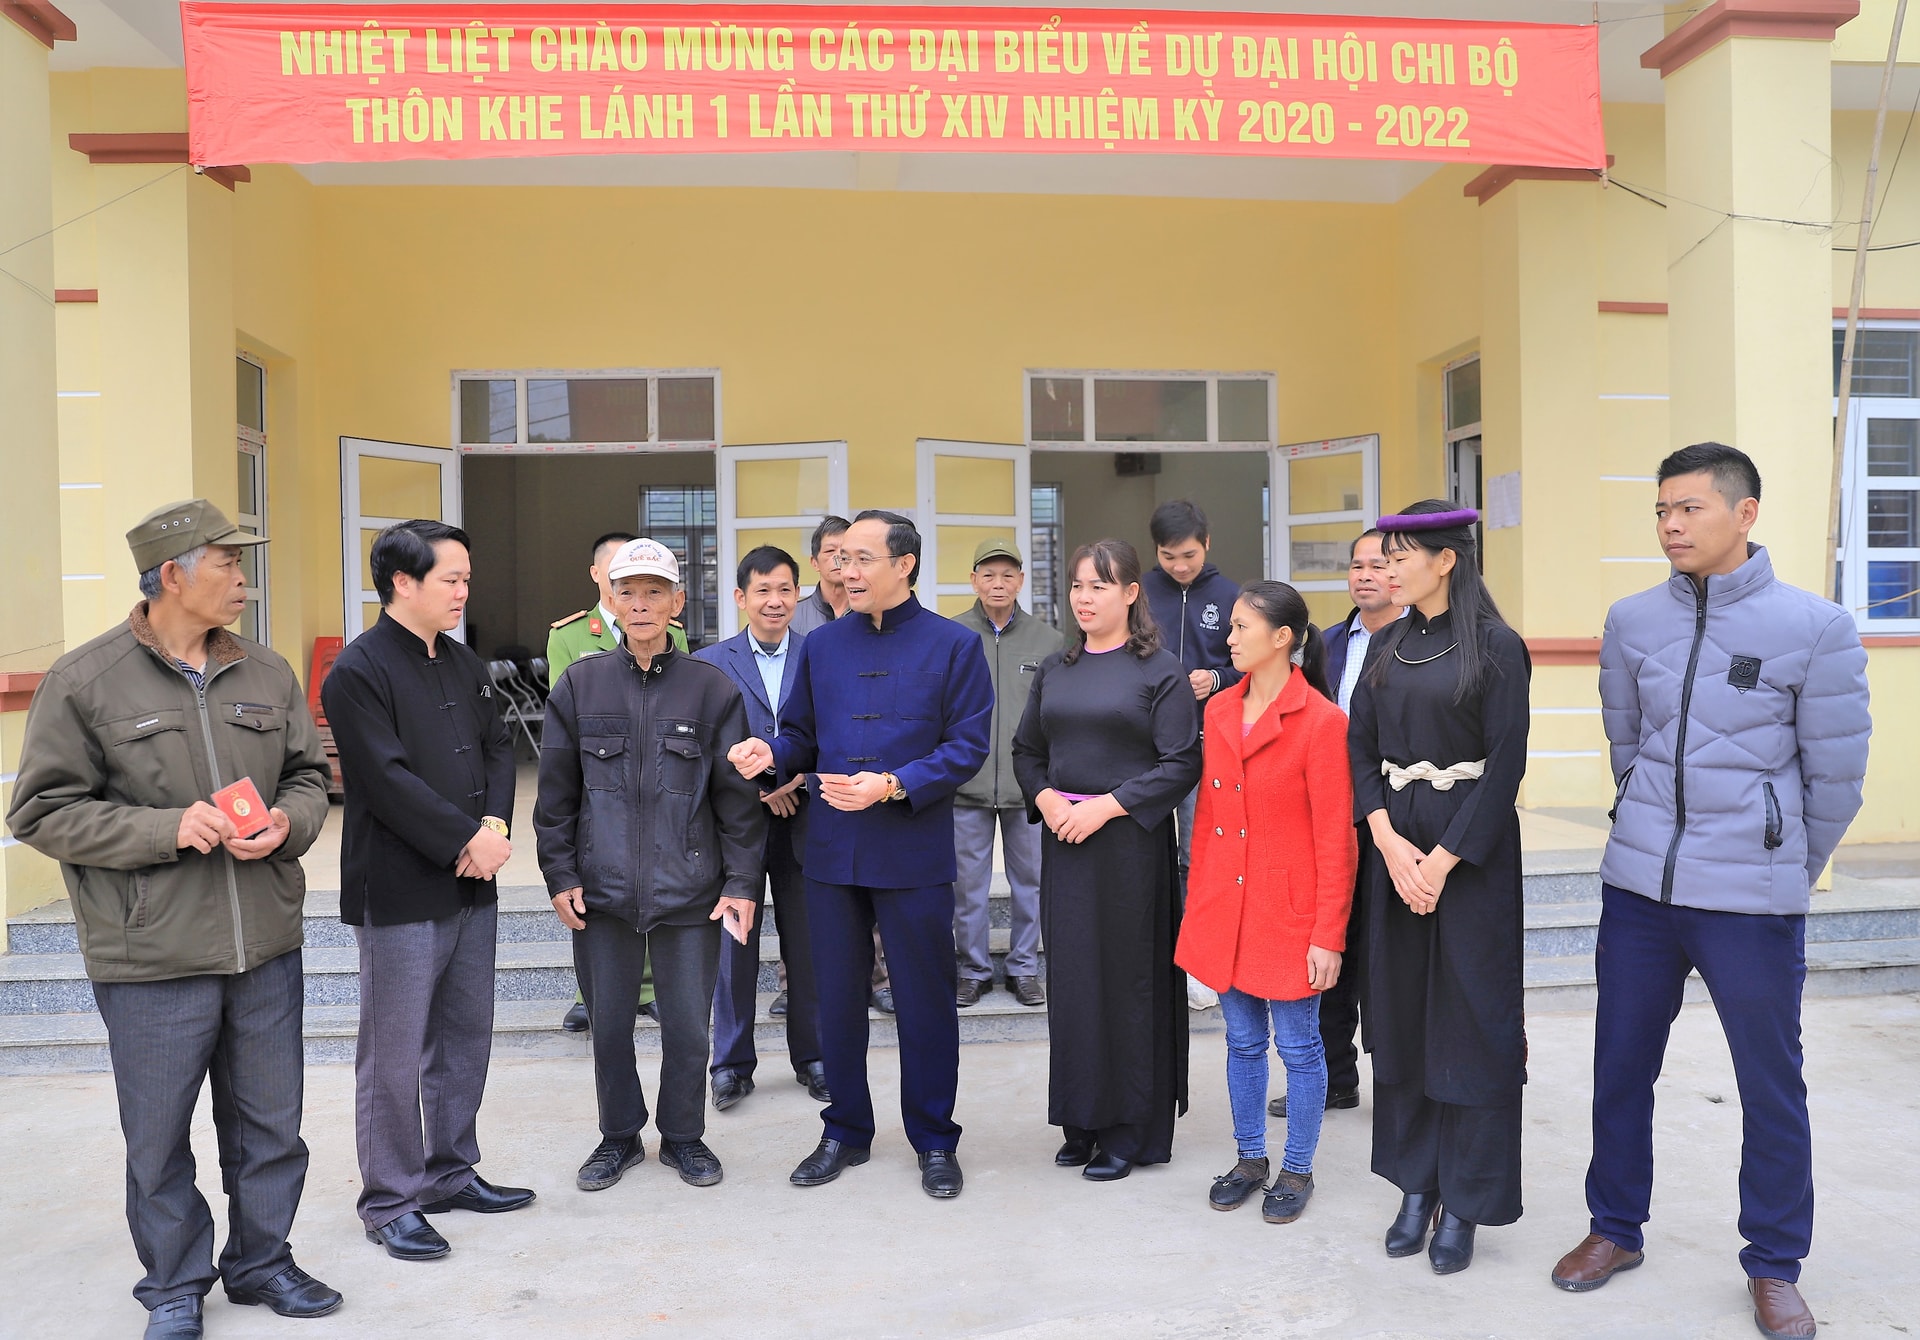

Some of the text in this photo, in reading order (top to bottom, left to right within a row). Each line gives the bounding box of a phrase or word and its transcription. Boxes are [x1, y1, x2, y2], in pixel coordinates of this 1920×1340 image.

[280, 15, 1519, 97] NHIỆT LIỆT CHÀO MỪNG CÁC ĐẠI BIỂU VỀ DỰ ĐẠI HỘI CHI BỘ
[345, 77, 1471, 149] THÔN KHE LÁNH 1 LẦN THỨ XIV NHIỆM KỲ 2020 - 2022
